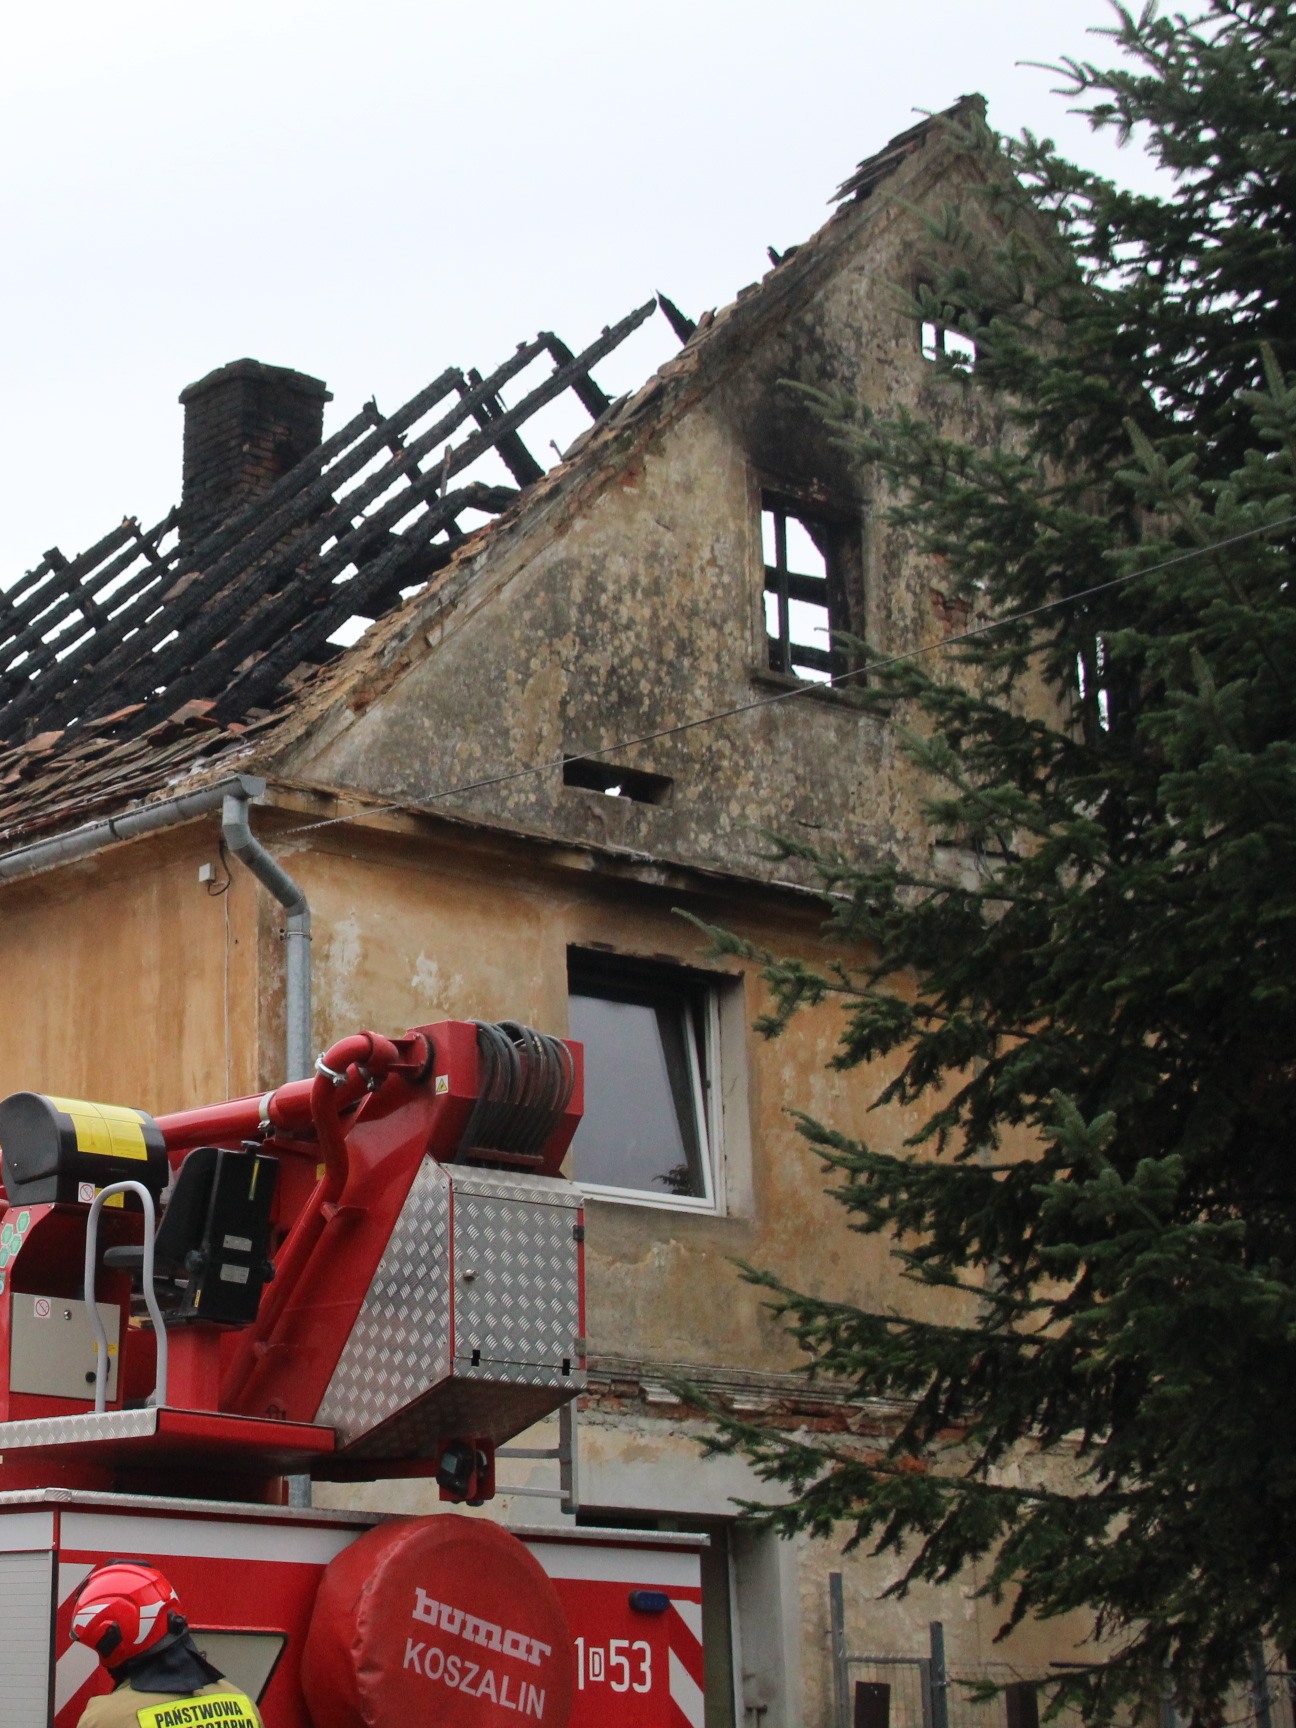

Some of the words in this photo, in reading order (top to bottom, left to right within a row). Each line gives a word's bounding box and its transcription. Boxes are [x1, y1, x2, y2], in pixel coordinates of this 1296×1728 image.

[412, 1587, 552, 1667] bumar
[403, 1638, 546, 1720] KOSZALIN
[154, 1701, 244, 1728] PAŃSTWOWA
[196, 1718, 255, 1728] ARNA
